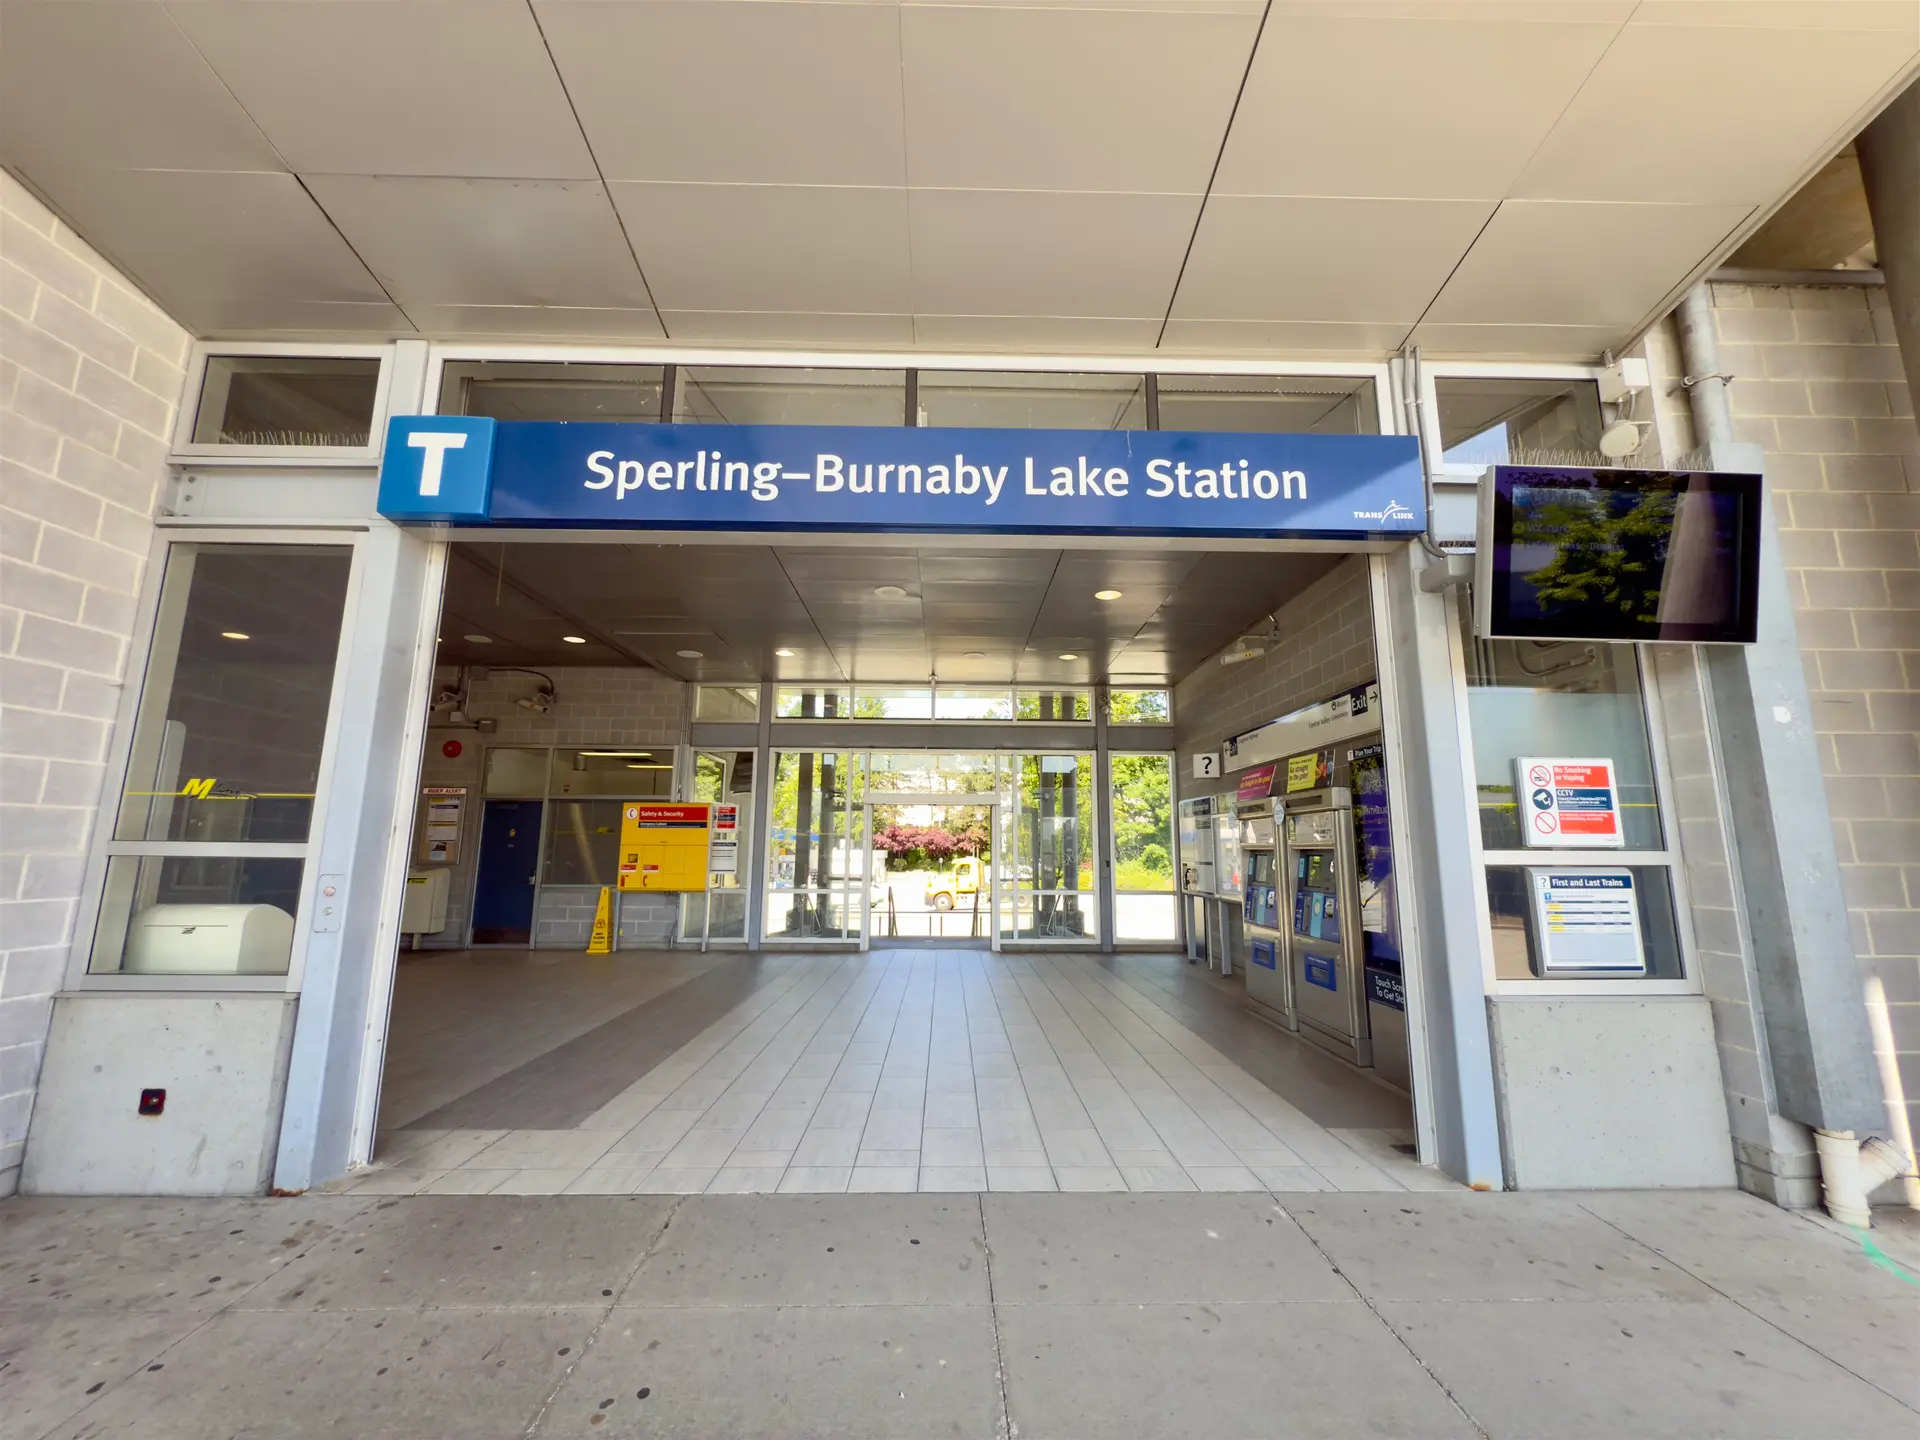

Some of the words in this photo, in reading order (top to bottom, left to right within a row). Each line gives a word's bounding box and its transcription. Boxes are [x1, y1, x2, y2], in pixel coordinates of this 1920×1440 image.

[407, 432, 467, 496] T
[1025, 456, 1129, 498] Lake
[1146, 459, 1307, 500] Station
[1351, 695, 1367, 711] Exit
[1374, 745, 1382, 753] Trip
[1202, 756, 1212, 775] ?
[1295, 764, 1309, 773] straight
[1564, 766, 1592, 775] Smoking
[1562, 774, 1585, 783] Vaping
[1557, 789, 1574, 797] CCTV
[663, 810, 684, 818] Security
[1552, 878, 1569, 887] First
[1570, 878, 1584, 887] and
[1585, 878, 1601, 887] Last
[1601, 878, 1624, 887] Trains
[1375, 975, 1391, 989] Touch
[1376, 986, 1383, 997] To
[1383, 989, 1394, 1000] Get
